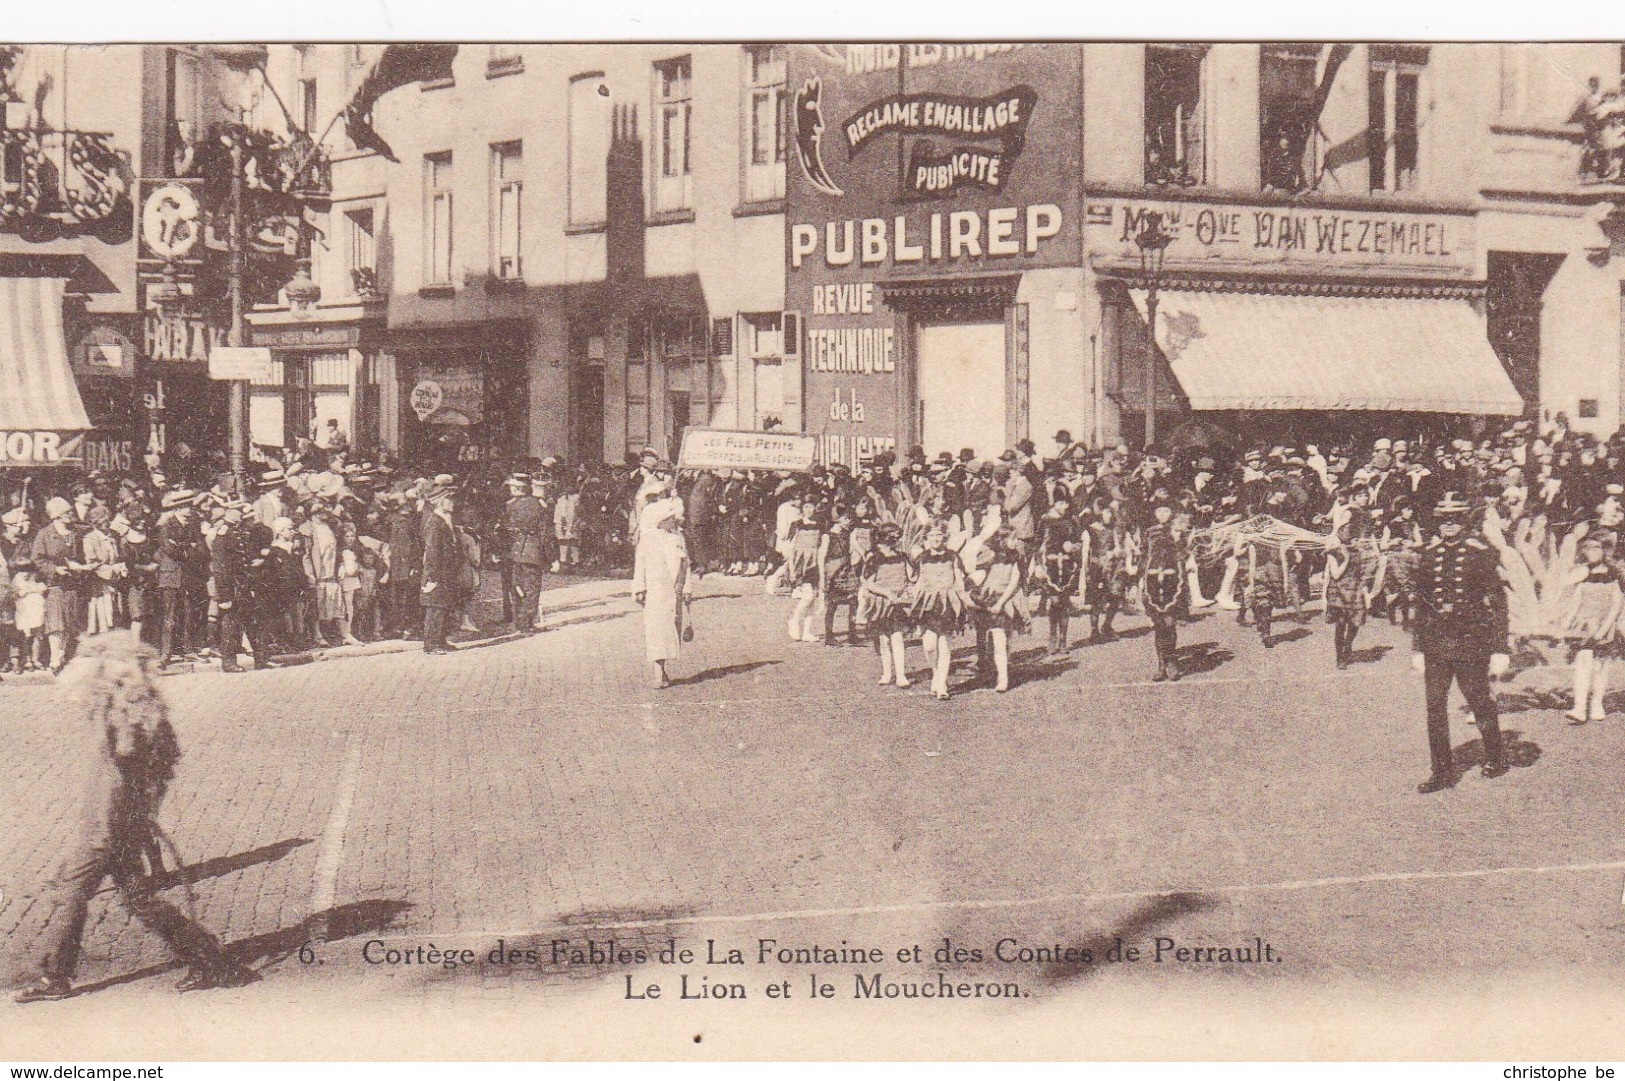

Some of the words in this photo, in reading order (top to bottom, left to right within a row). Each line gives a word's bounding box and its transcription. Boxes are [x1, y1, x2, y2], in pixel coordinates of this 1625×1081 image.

[847, 102, 919, 146] RECLAME
[792, 204, 1063, 268] PUBLIREP
[1313, 215, 1452, 257] WEZEMAEL
[813, 283, 873, 314] REVUE
[809, 328, 894, 374] TECHNIQUE
[830, 388, 849, 421] de
[852, 388, 865, 422] la
[299, 942, 325, 966] 6.
[362, 940, 475, 969] Cortège
[488, 940, 537, 965] des
[550, 940, 646, 965] Fables
[659, 940, 694, 965] de
[706, 940, 744, 965] La
[758, 940, 883, 965] Fontaine
[896, 943, 922, 964] et
[934, 939, 983, 964] des
[995, 939, 1093, 964] Contes
[1106, 939, 1140, 963] de
[1153, 939, 1284, 964] Perrault.
[625, 975, 661, 1000] Le
[681, 975, 747, 1000] Lion
[766, 979, 792, 1000] et
[811, 974, 835, 999] le
[854, 974, 1030, 999] Moucheron.
